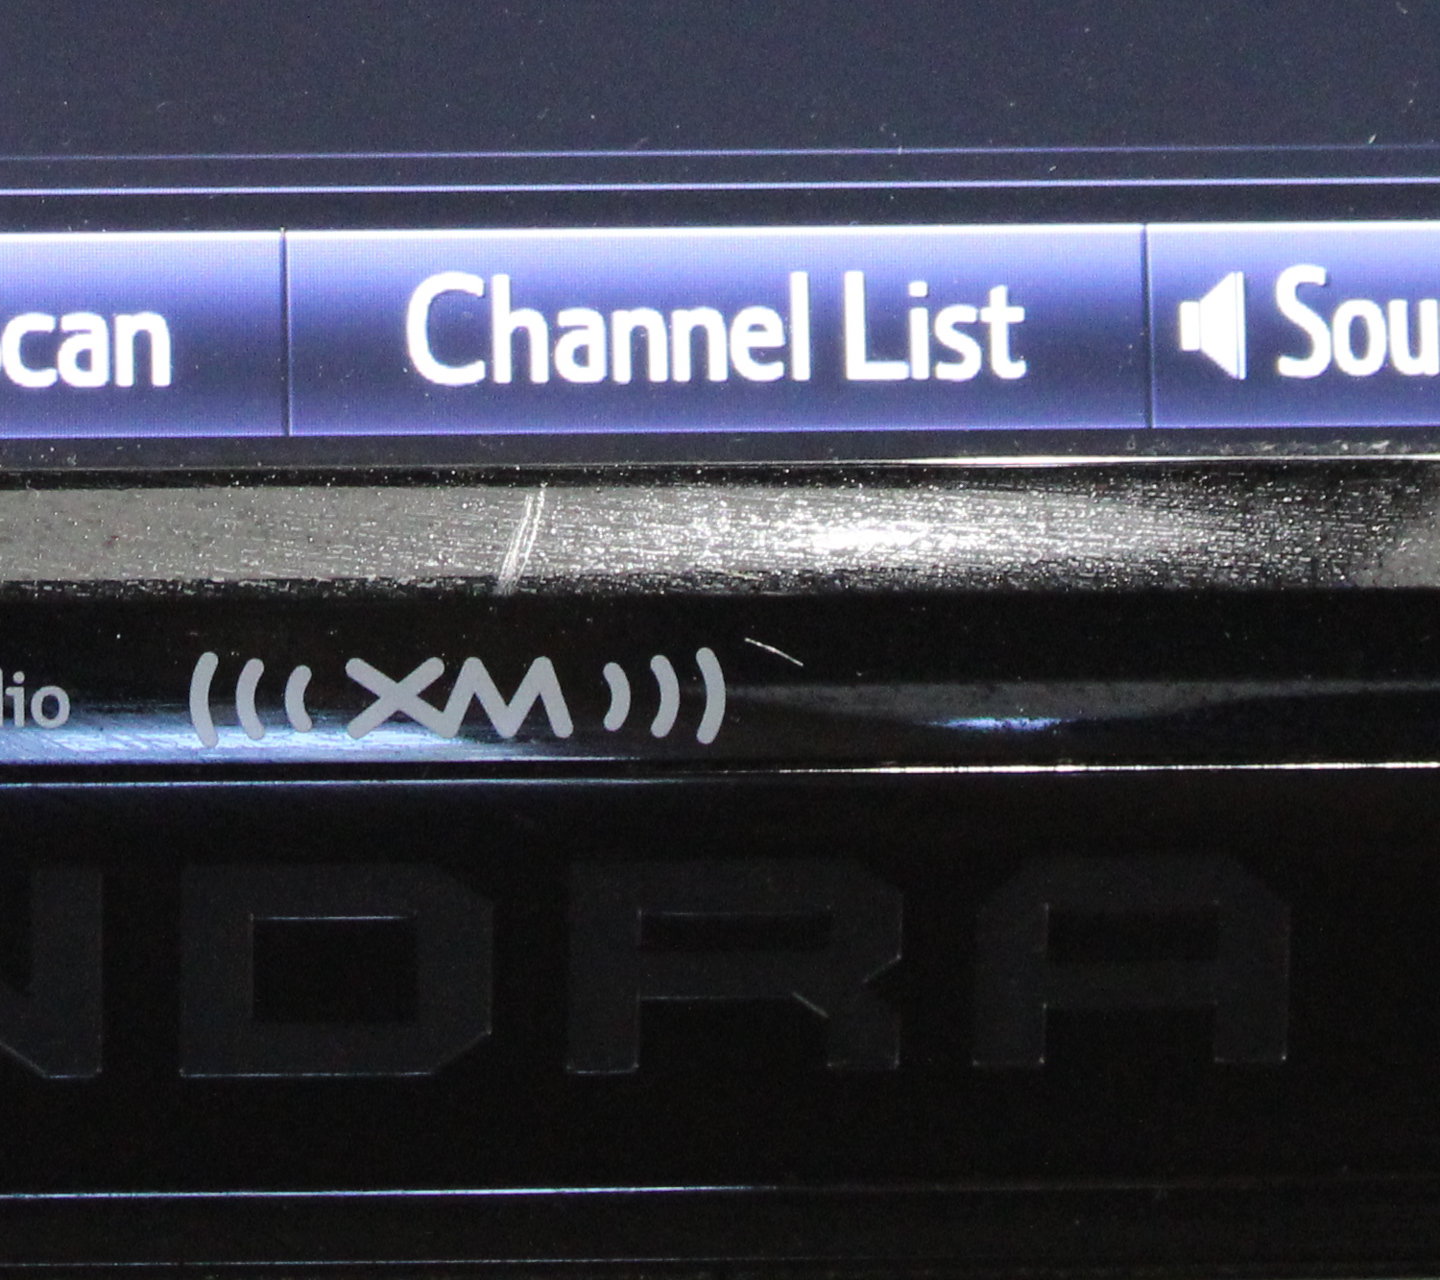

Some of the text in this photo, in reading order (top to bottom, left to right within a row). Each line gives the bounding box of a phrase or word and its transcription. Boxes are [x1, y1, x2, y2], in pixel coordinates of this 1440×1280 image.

[404, 268, 1027, 389] Channel List
[345, 655, 574, 740] XM
